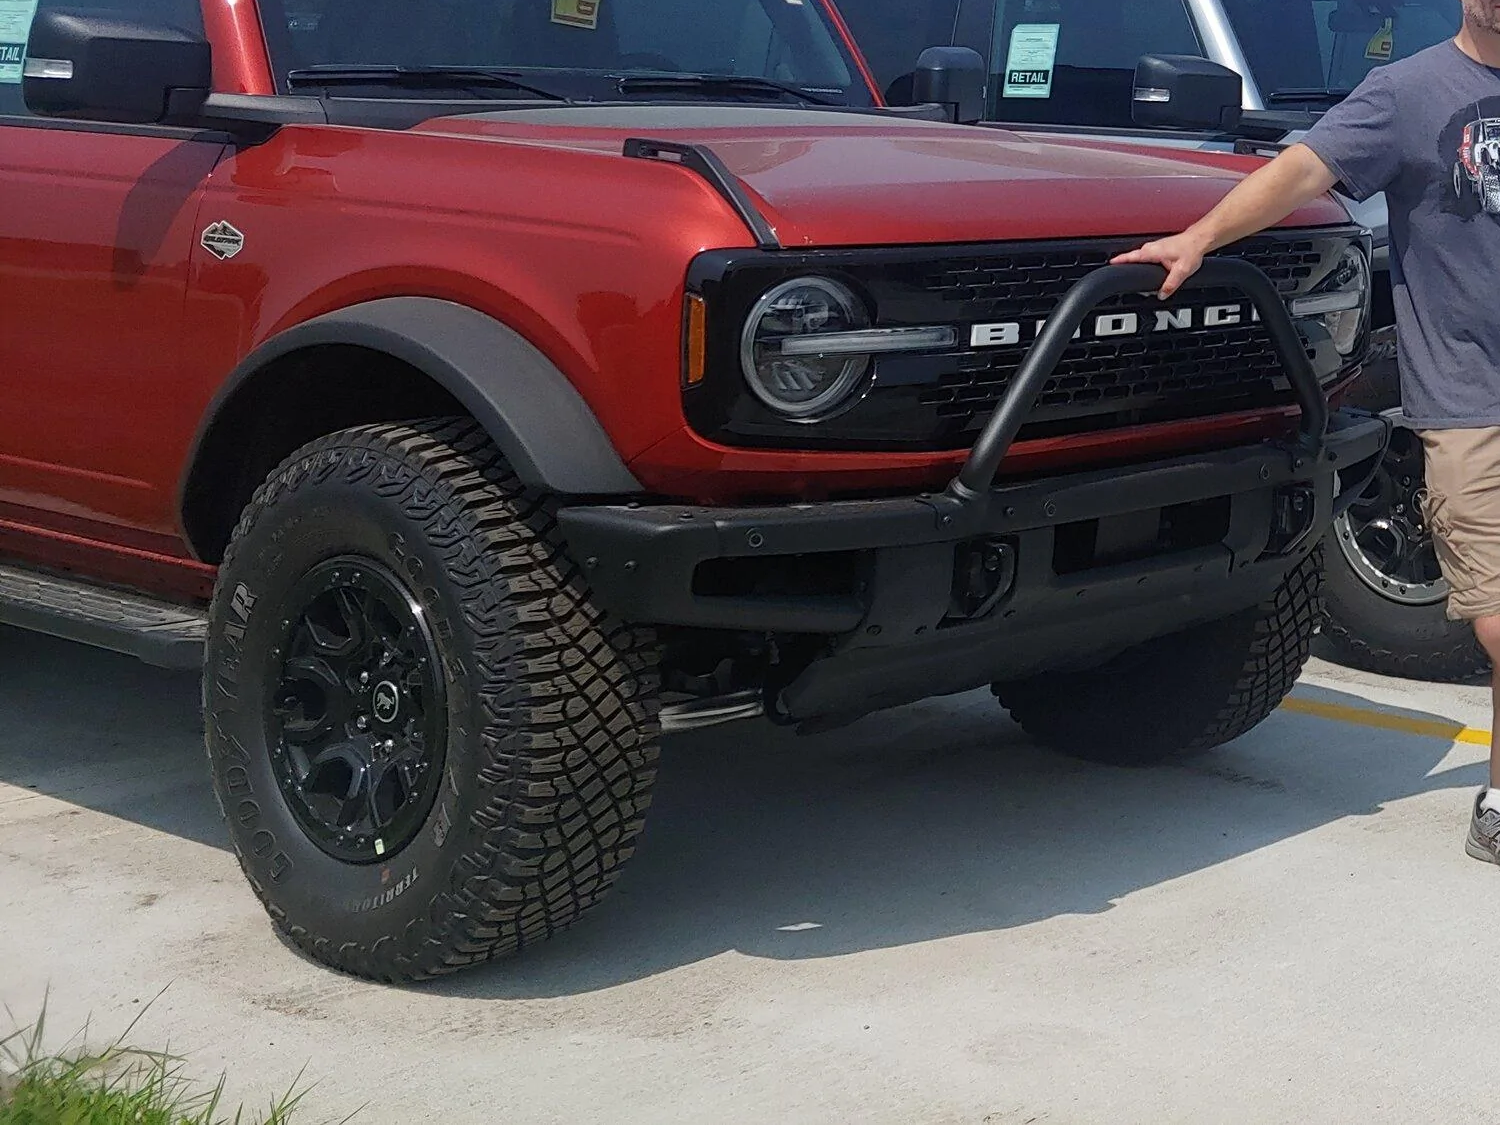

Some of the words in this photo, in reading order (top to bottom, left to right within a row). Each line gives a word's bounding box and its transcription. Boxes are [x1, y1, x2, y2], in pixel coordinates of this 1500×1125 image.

[0, 46, 20, 61] TAIL
[1011, 72, 1046, 83] RETAIL
[970, 304, 1262, 347] BONC
[349, 866, 419, 913] TERRITOR
